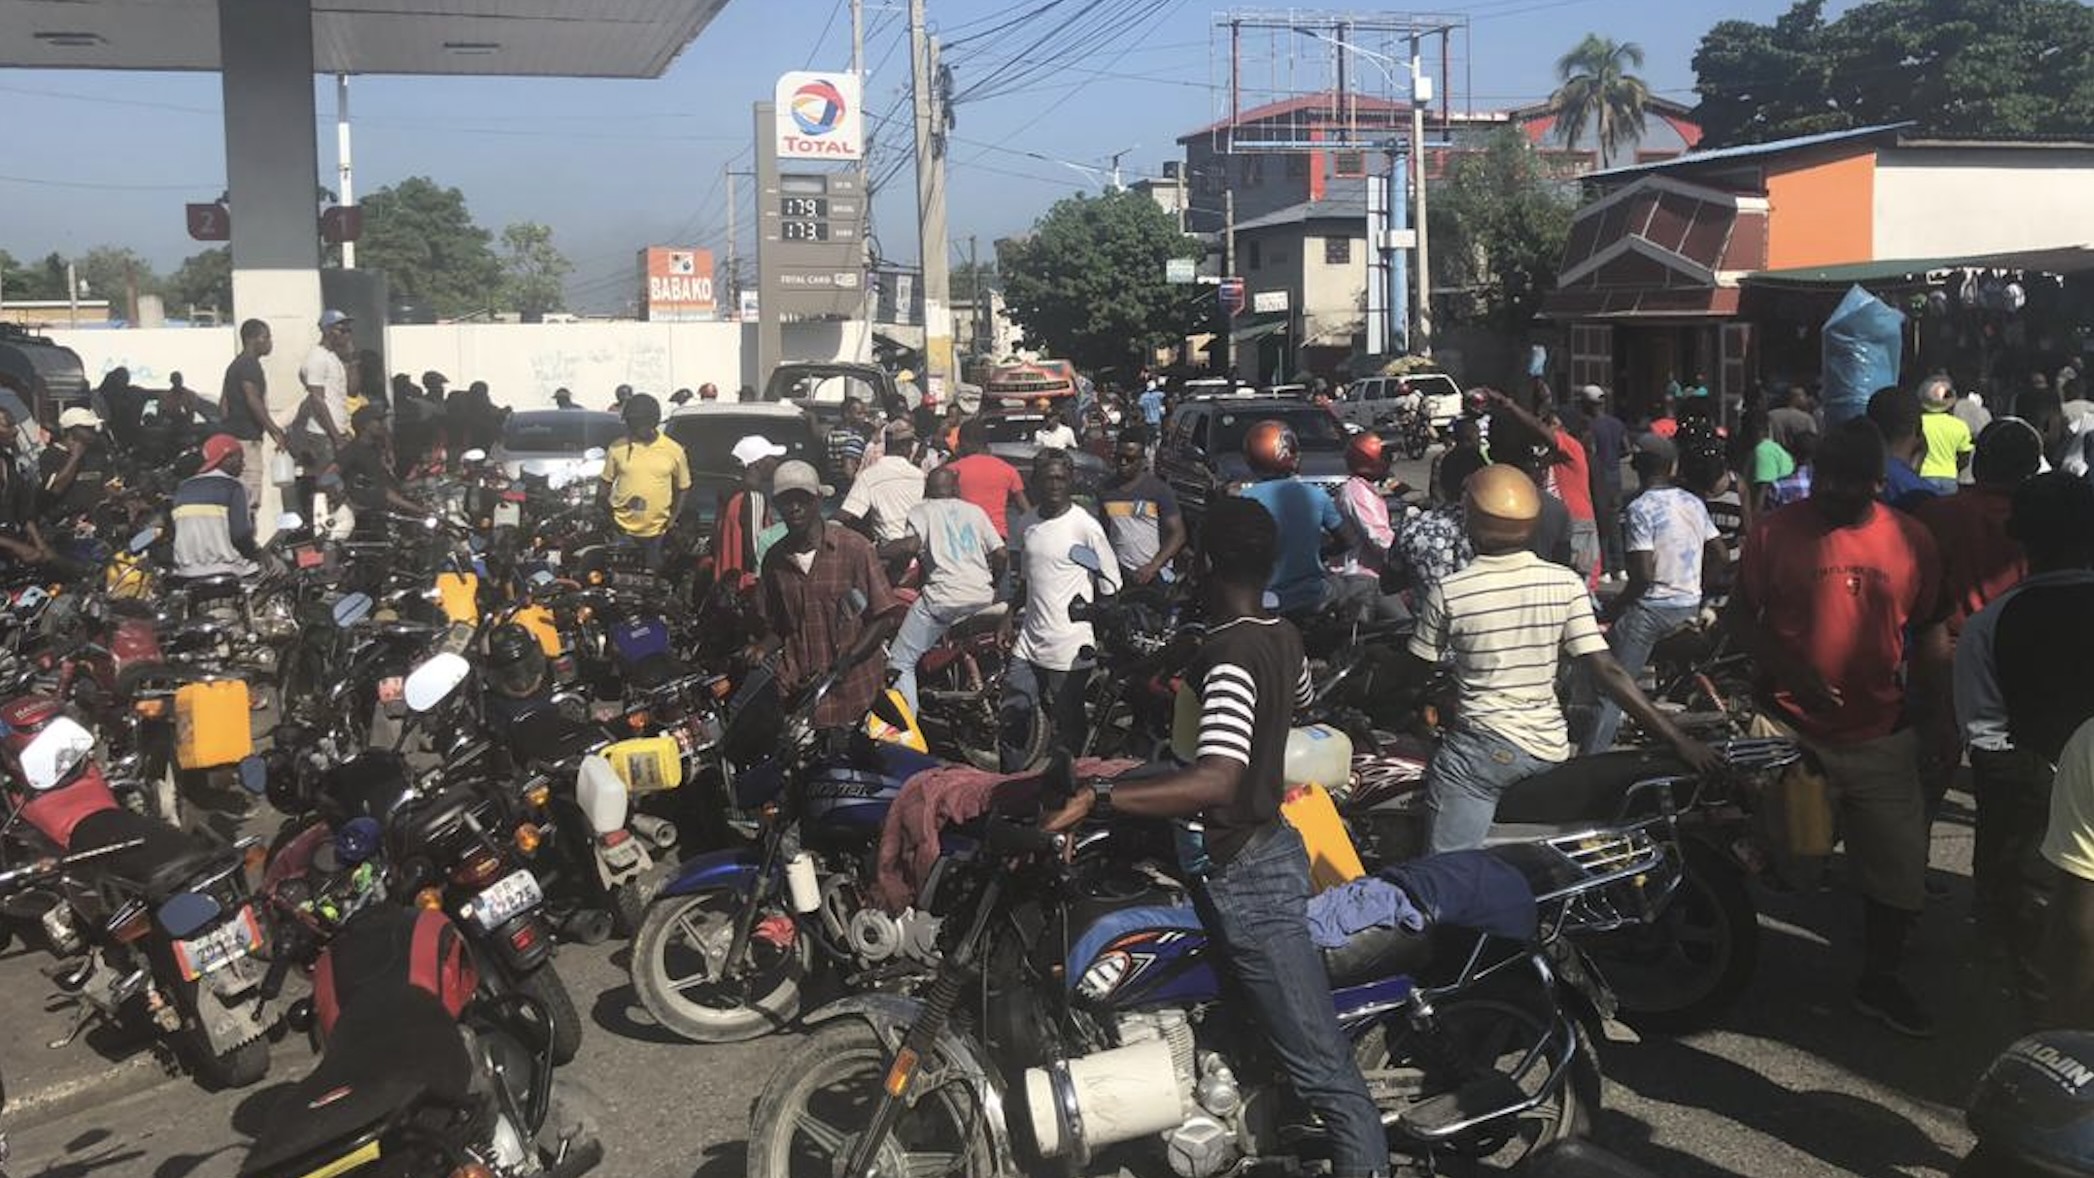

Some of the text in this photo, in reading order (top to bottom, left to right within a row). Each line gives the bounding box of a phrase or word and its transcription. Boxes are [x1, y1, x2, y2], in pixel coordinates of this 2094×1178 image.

[783, 136, 855, 154] TOTAL
[201, 211, 215, 234] 2
[336, 215, 348, 233] 1
[651, 276, 712, 302] BABAKO
